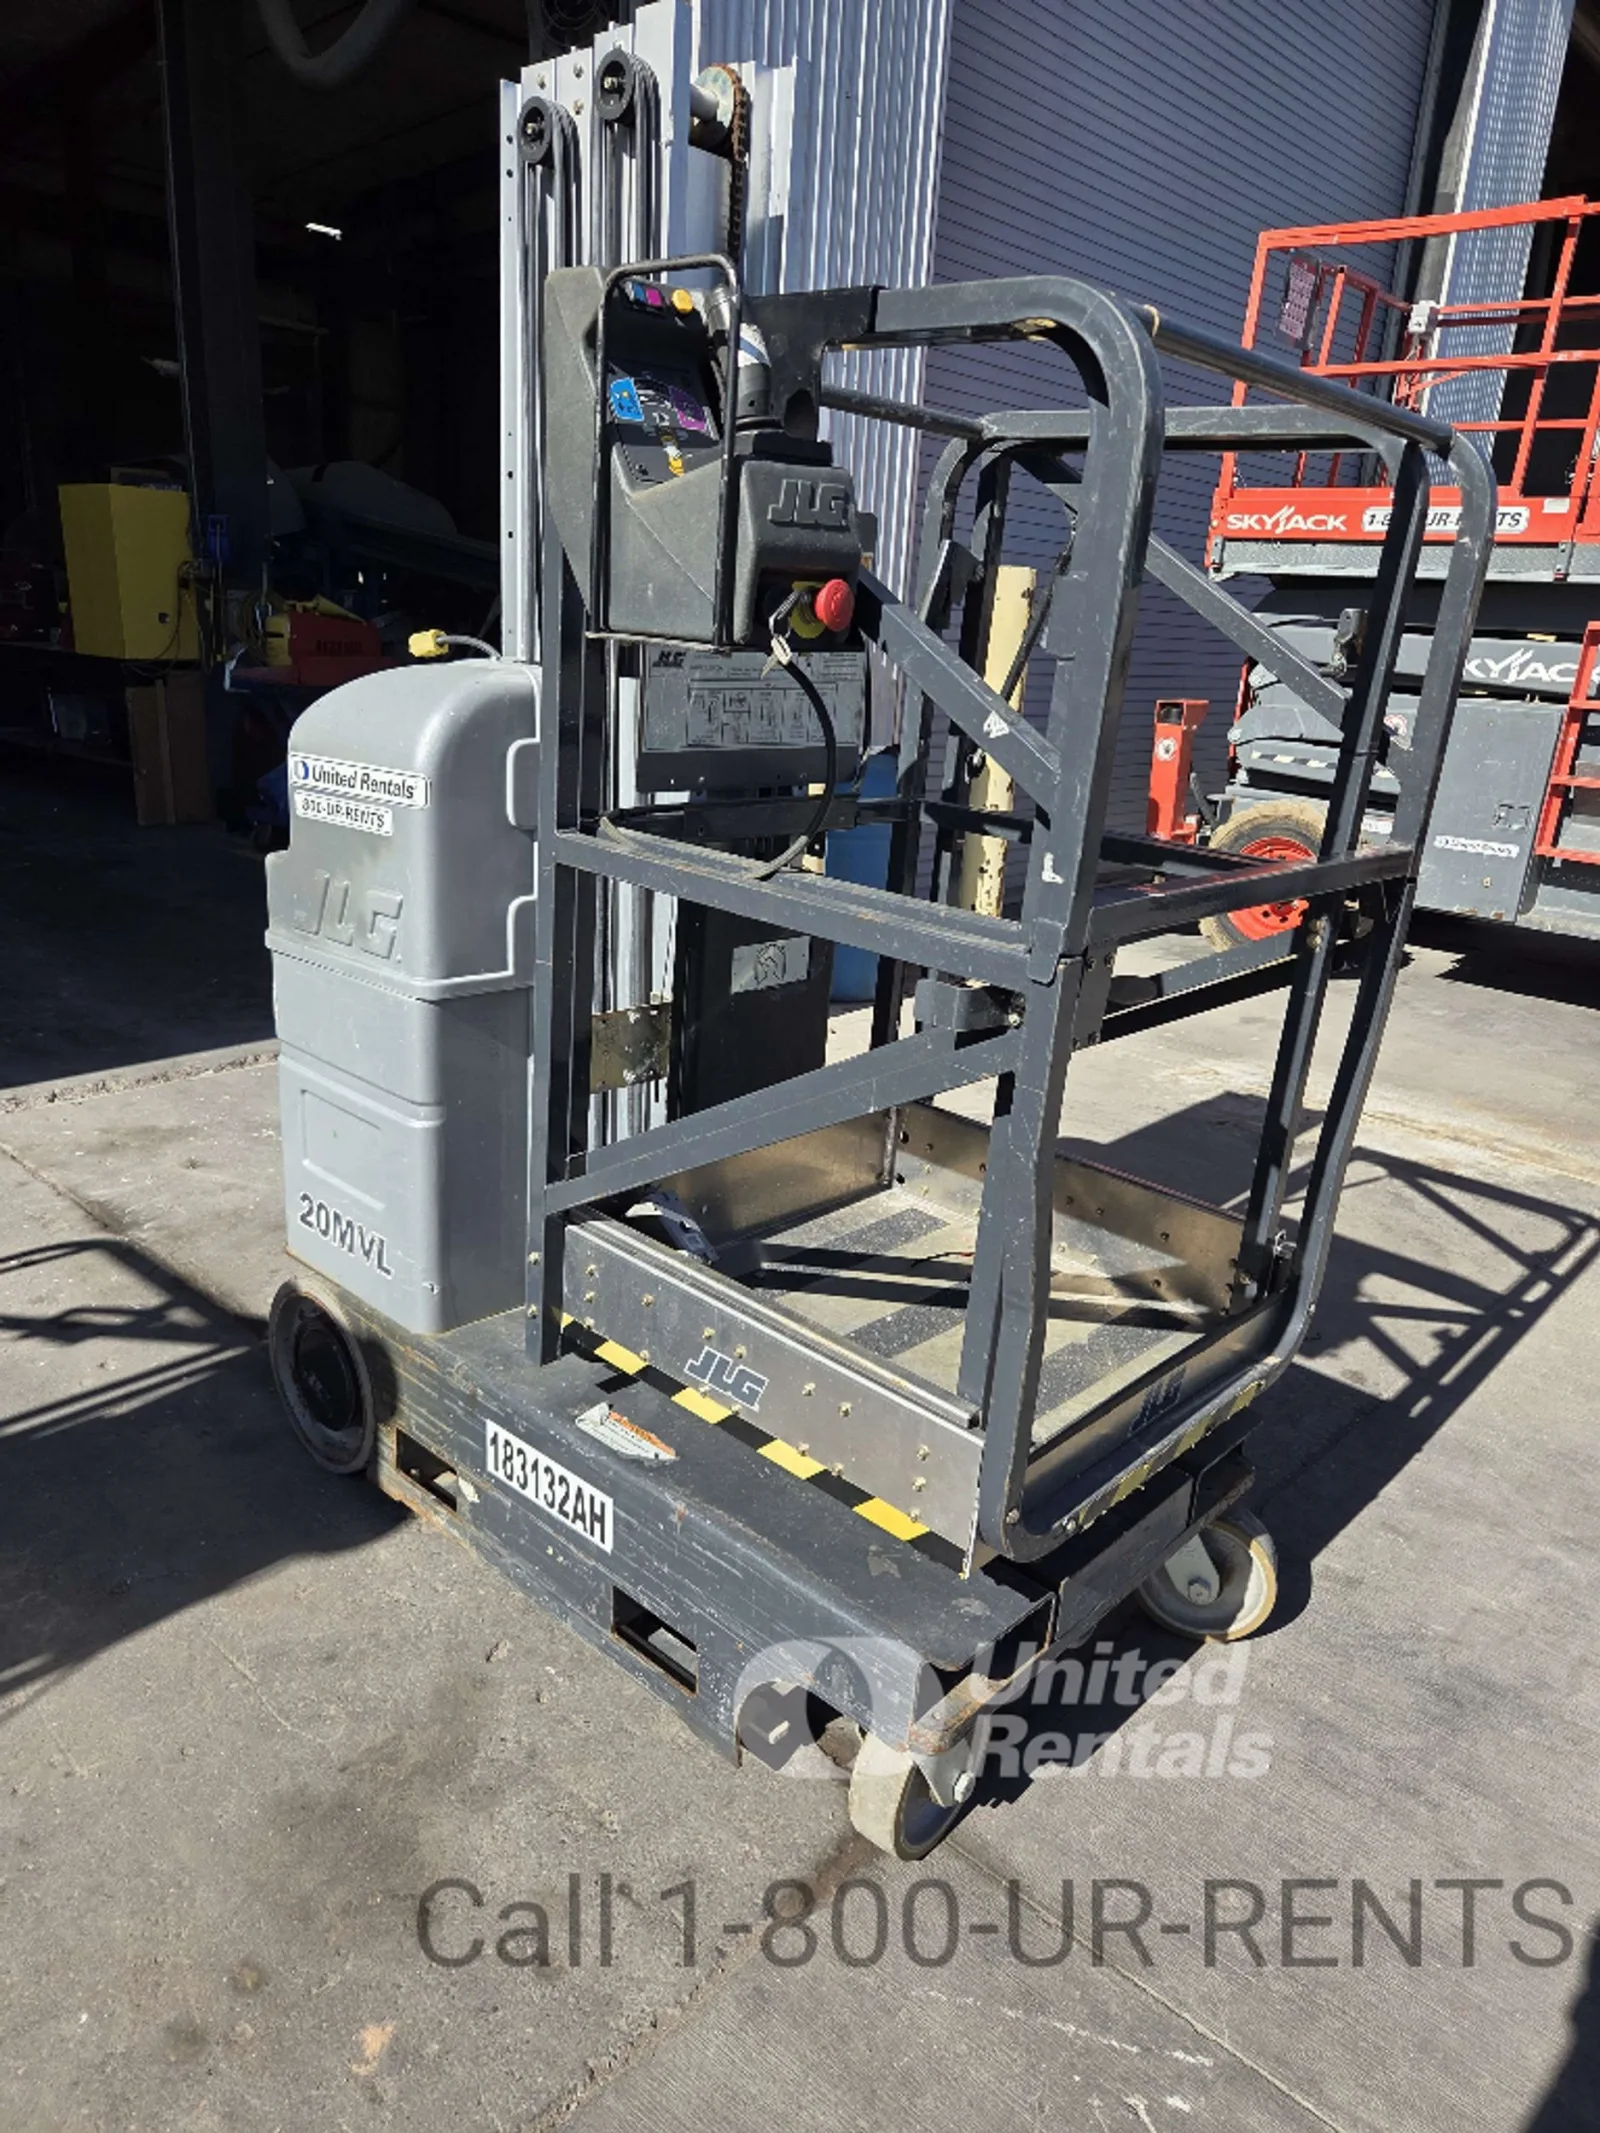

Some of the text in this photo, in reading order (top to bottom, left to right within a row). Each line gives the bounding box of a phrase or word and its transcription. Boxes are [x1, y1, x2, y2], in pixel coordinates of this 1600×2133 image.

[768, 478, 850, 528] JLG
[1226, 504, 1348, 535] SKYJACK
[312, 763, 415, 800] United Rentals
[290, 870, 404, 961] JLG
[299, 1191, 393, 1278] 20MVL
[684, 1345, 770, 1411] JLG
[489, 1431, 607, 1546] 183132AH
